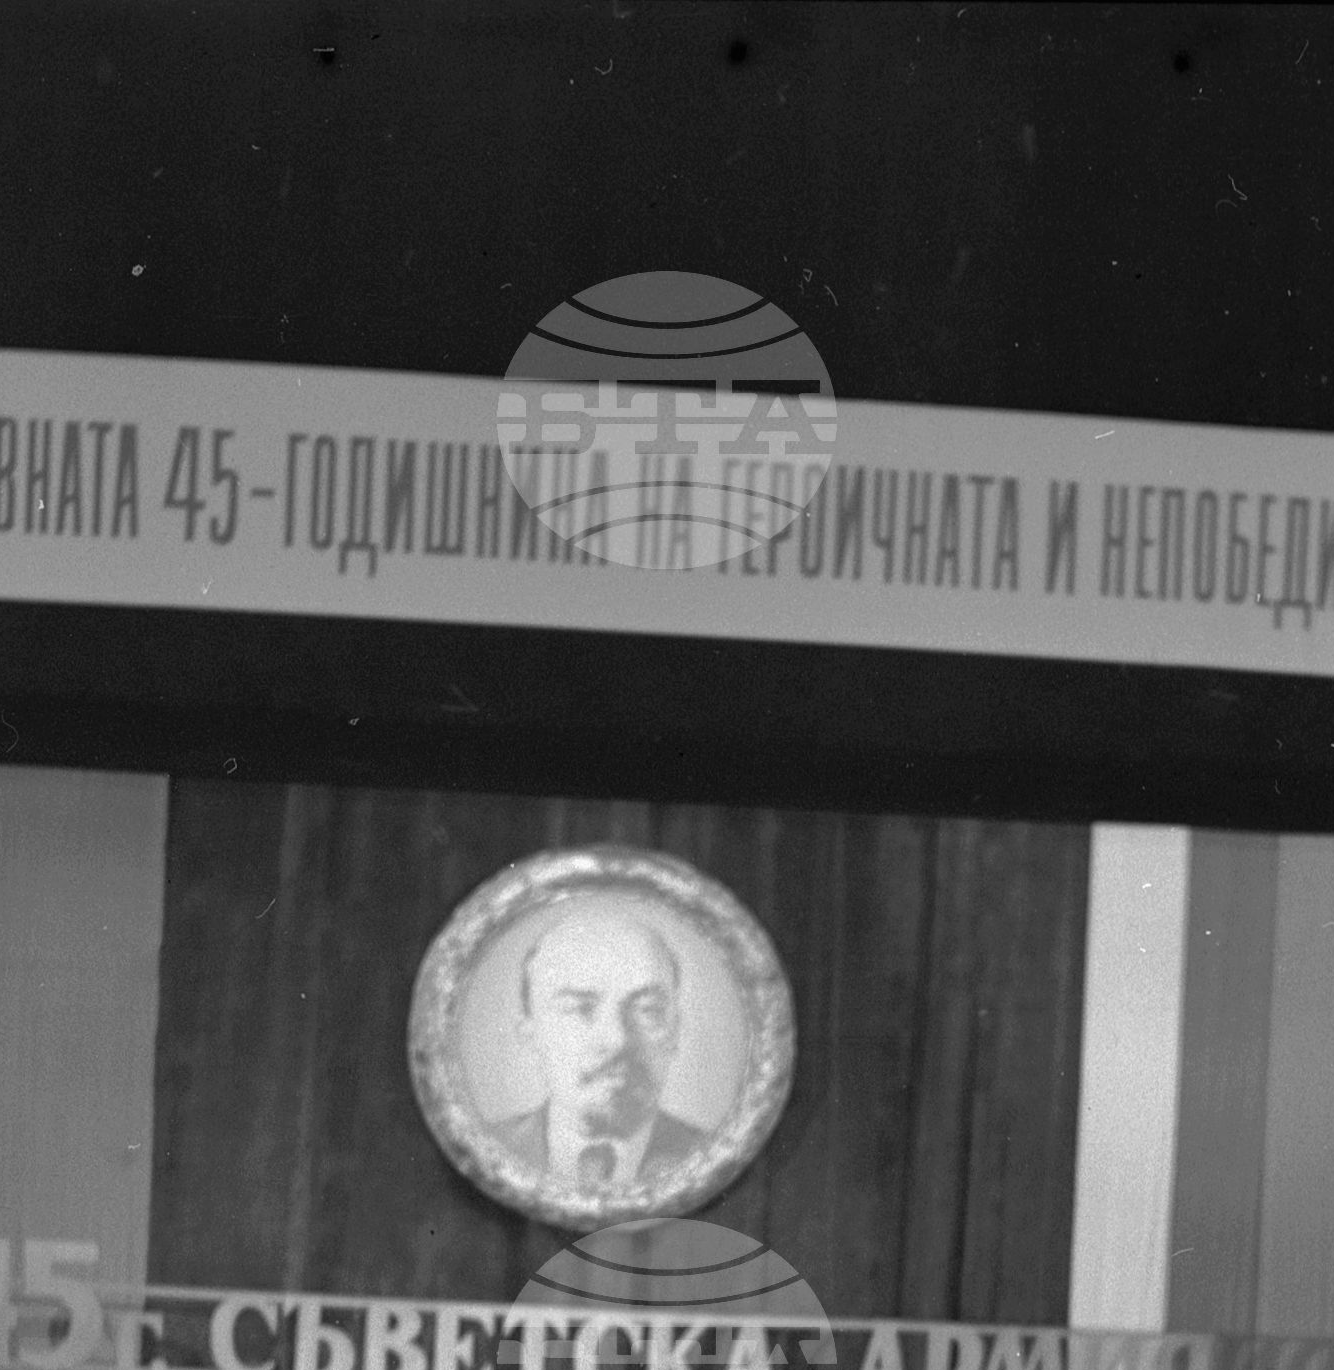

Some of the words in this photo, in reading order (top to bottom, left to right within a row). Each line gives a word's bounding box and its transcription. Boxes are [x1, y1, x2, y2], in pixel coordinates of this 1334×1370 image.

[634, 448, 695, 571] НА
[717, 455, 1021, 594] ГЕРОИЧНАТА
[1044, 479, 1080, 596] И
